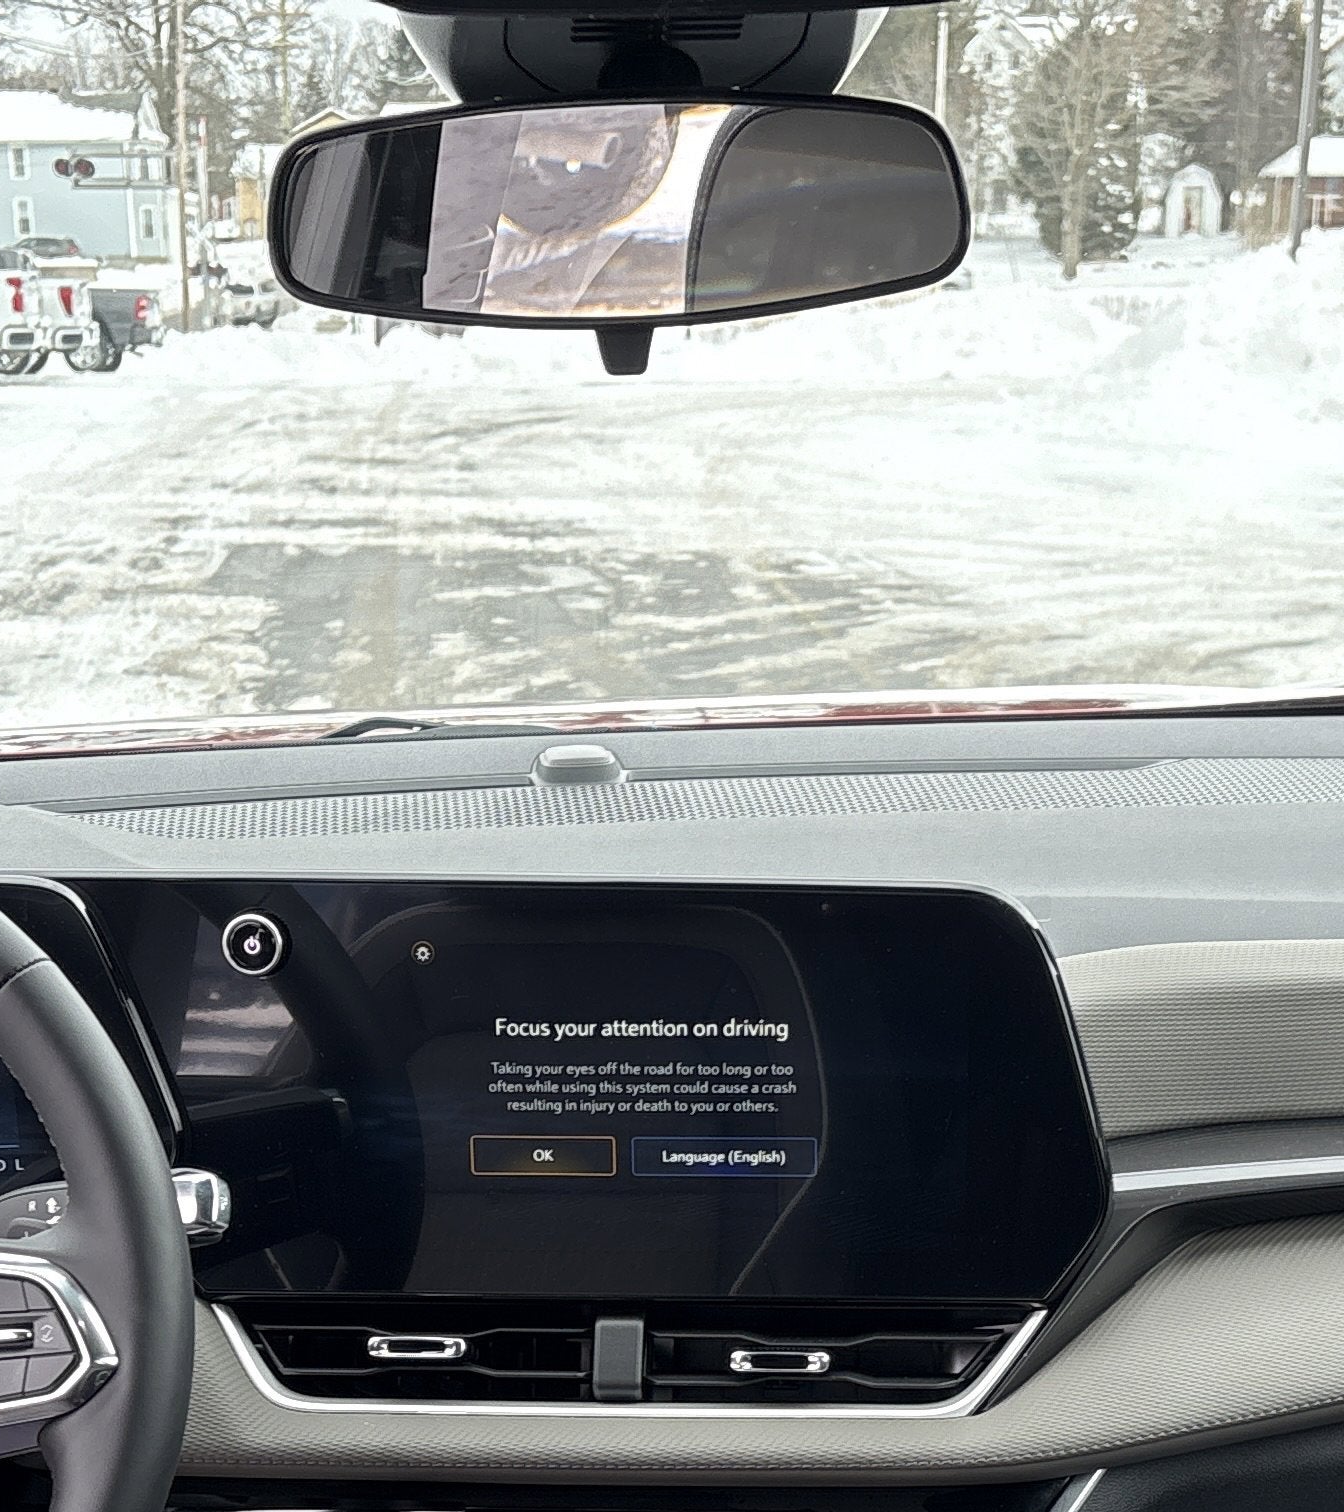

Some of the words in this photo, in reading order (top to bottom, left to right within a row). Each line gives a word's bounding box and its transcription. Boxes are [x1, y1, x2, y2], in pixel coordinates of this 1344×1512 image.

[495, 1017, 550, 1036] Focus
[554, 1021, 597, 1041] your
[601, 1018, 688, 1037] attention
[693, 1022, 717, 1037] on
[723, 1018, 789, 1041] driving
[490, 1061, 533, 1078] Taking
[535, 1064, 564, 1078] your
[566, 1065, 596, 1078] eyes
[598, 1061, 618, 1075] off
[620, 1062, 641, 1075] the
[644, 1062, 673, 1075] road
[676, 1062, 695, 1075] for
[698, 1063, 720, 1076] too
[722, 1062, 752, 1079] long
[754, 1065, 769, 1076] or
[771, 1063, 794, 1076] too
[488, 1079, 523, 1093] often
[525, 1080, 559, 1093] while
[562, 1082, 597, 1096] using
[599, 1081, 623, 1093] this
[626, 1082, 671, 1096] system
[673, 1081, 709, 1094] could
[711, 1083, 749, 1094] cause
[751, 1083, 759, 1094] a
[761, 1081, 797, 1094] crash
[507, 1099, 562, 1114] resulting
[565, 1099, 577, 1111] in
[579, 1099, 615, 1114] injury
[618, 1101, 632, 1112] or
[634, 1099, 671, 1112] death
[674, 1100, 688, 1112] to
[690, 1102, 714, 1115] you
[716, 1102, 731, 1112] or
[733, 1099, 779, 1112] others.
[533, 1149, 554, 1162] OK
[662, 1150, 725, 1166] Language
[727, 1150, 786, 1167] (English)
[15, 1158, 25, 1171] L
